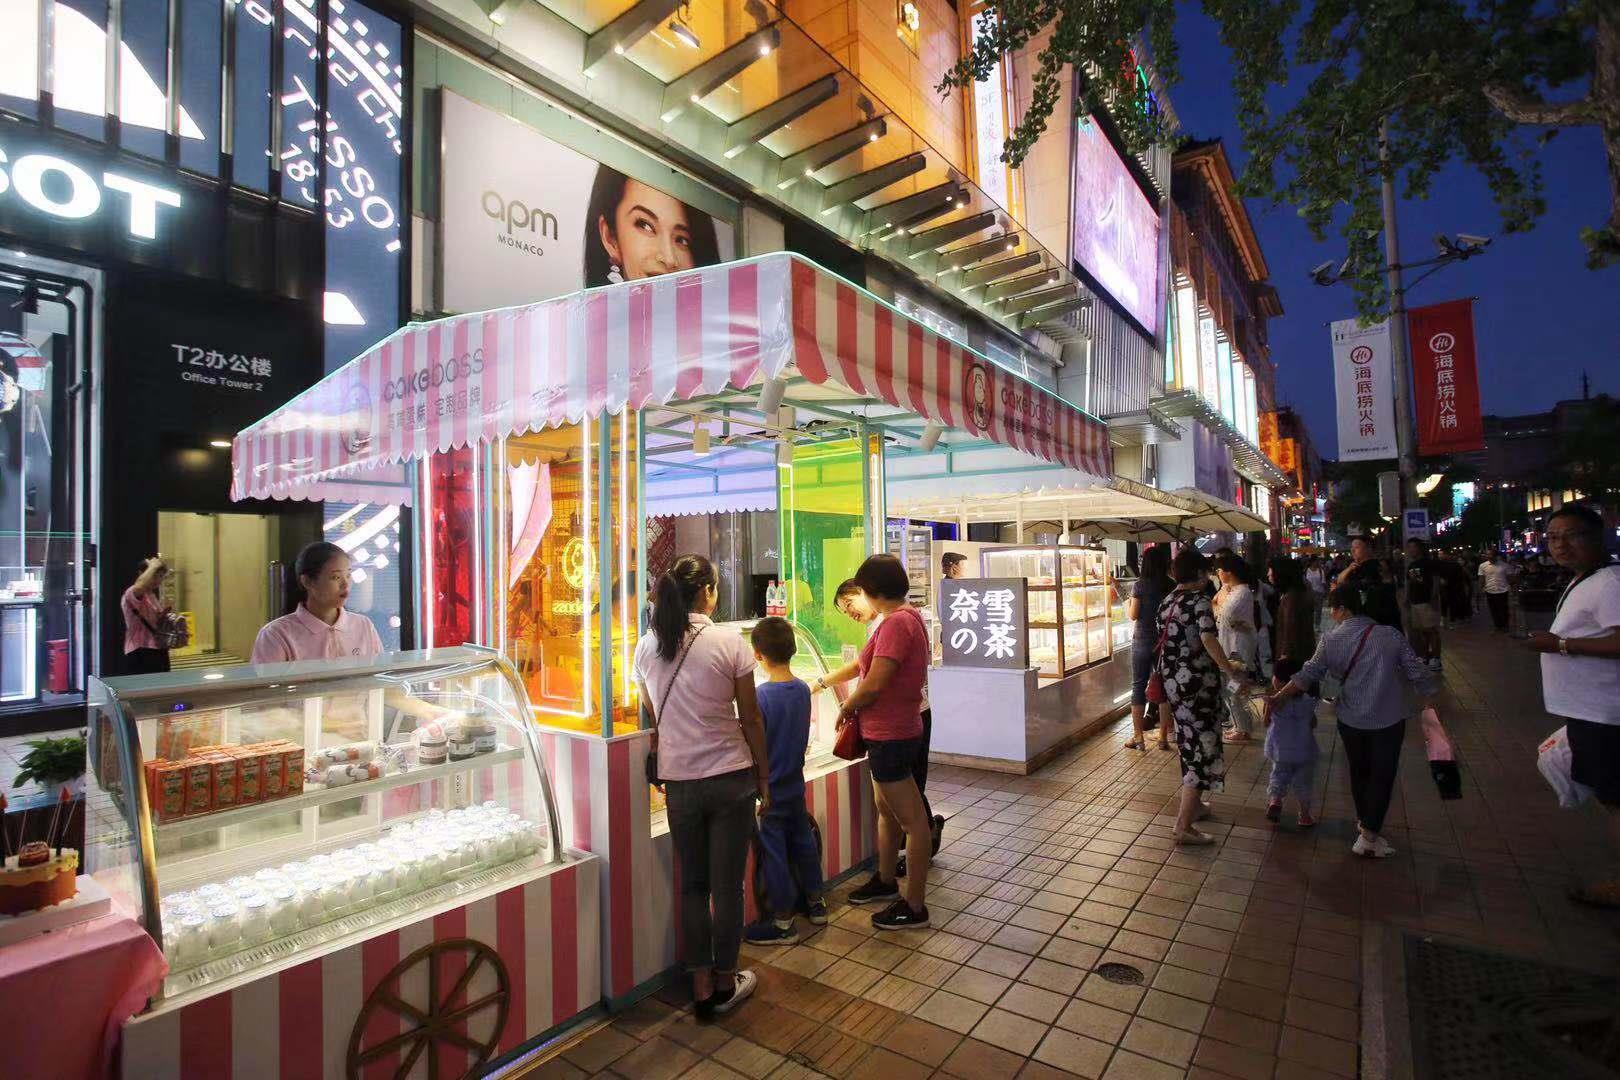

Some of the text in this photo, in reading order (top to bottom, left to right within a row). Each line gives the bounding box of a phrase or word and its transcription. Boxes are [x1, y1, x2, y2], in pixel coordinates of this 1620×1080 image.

[0, 149, 181, 239] OT
[279, 143, 355, 228] 1853
[481, 191, 558, 241] apm
[497, 233, 544, 257] MONACO
[171, 344, 272, 377] T2办公楼
[182, 371, 263, 391] Office Tower 2
[1354, 366, 1375, 437] 海底捞火锅
[1434, 354, 1457, 429] 海底捞火锅
[949, 588, 1016, 623] 奈雪
[950, 623, 1018, 659] の茶
